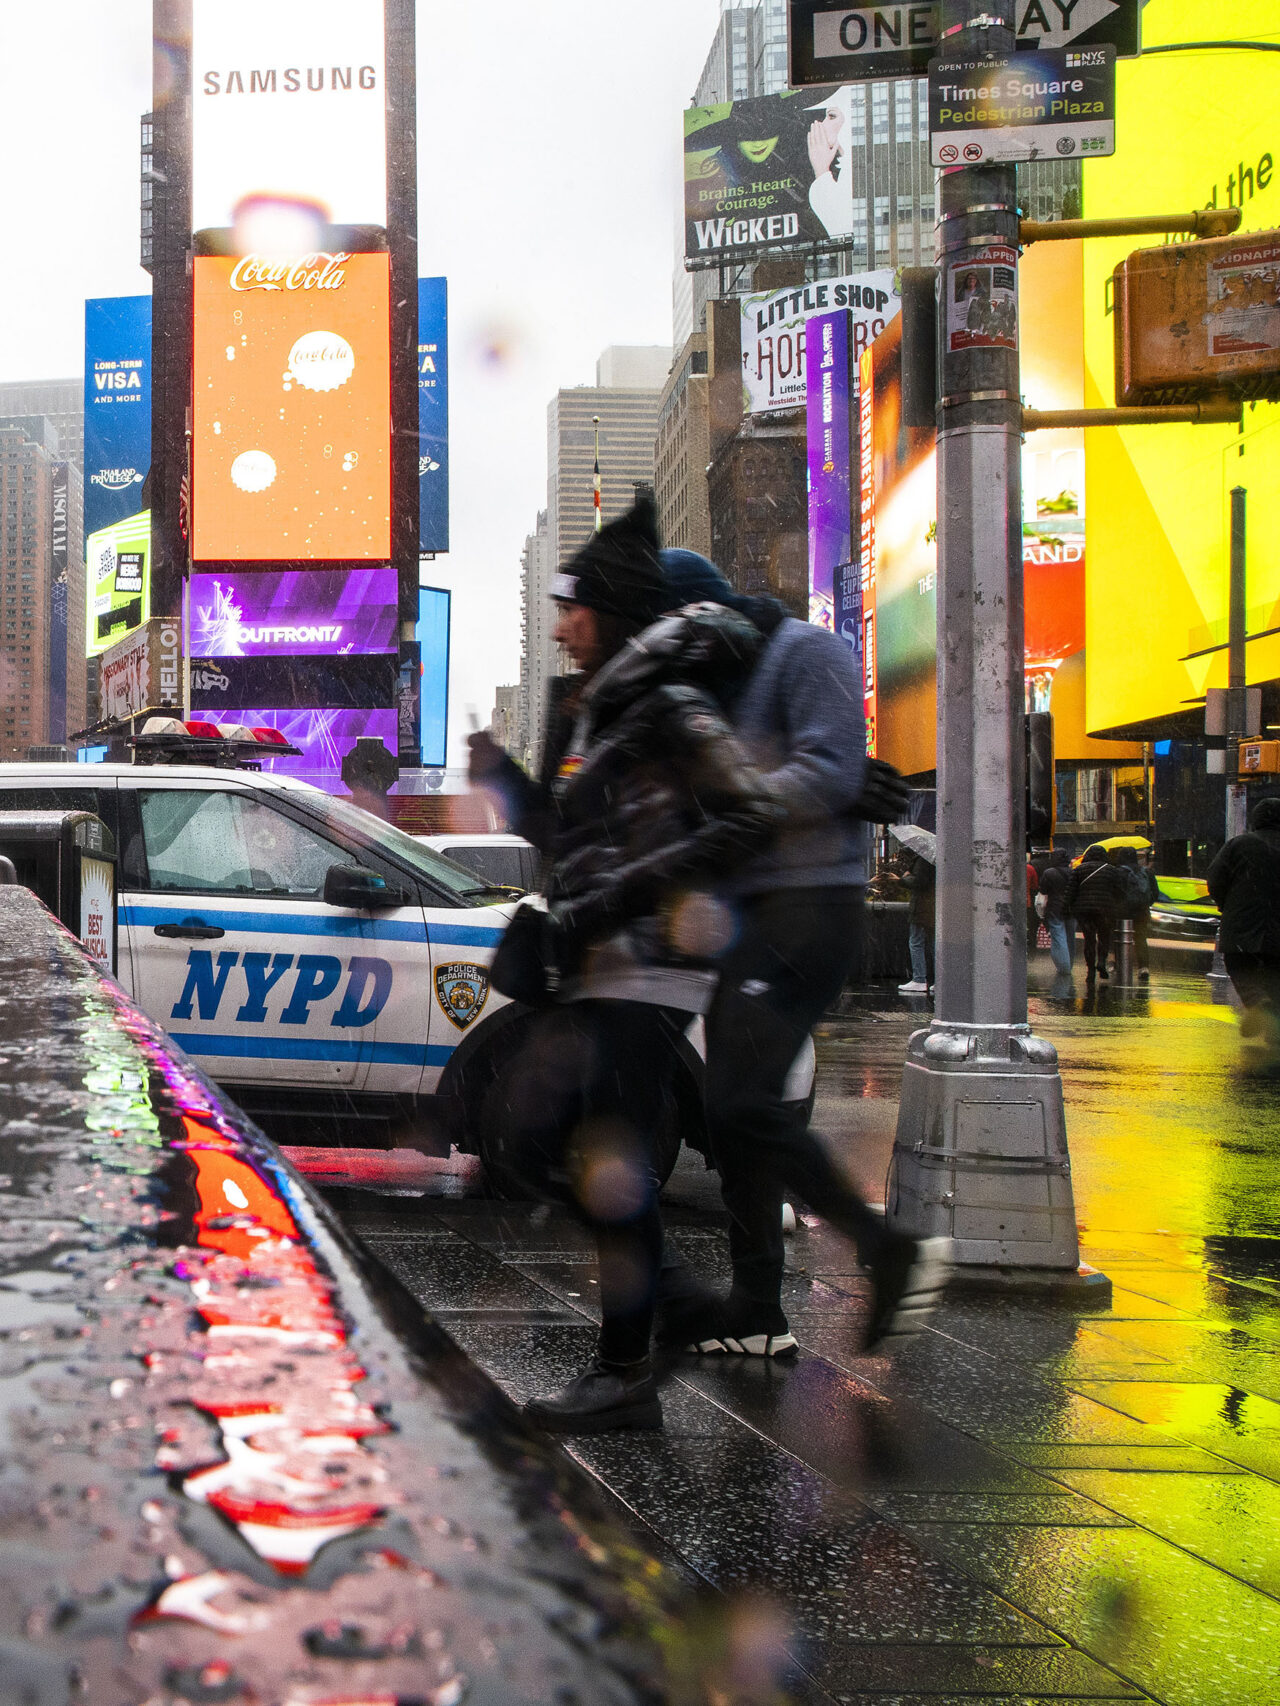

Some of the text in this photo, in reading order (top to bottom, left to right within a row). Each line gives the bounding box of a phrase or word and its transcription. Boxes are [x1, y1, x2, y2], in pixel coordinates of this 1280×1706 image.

[1019, 0, 1079, 35] AY
[839, 8, 933, 50] ONE
[938, 59, 1009, 72] OPEN TO PUBLIC
[1081, 51, 1106, 61] NYC
[203, 65, 377, 96] SAMSUNG
[938, 79, 1084, 102] Times Square
[939, 99, 1105, 124] Pedestrian Plaza
[698, 177, 797, 202] Brains. Heart.
[1227, 153, 1273, 209] the
[715, 195, 779, 212] Courage.
[1220, 248, 1280, 264] KIDNAPP
[757, 284, 889, 334] LITTLE SHOP
[418, 344, 437, 353] ERM
[757, 318, 886, 394] HORRS
[94, 360, 143, 370] LONG-TERM
[94, 371, 141, 390] VISA
[780, 382, 807, 394] LittleS
[116, 394, 141, 403] MORE
[768, 396, 796, 406] Westside
[90, 474, 132, 484] PRIVILEGE
[100, 468, 136, 478] THAILAND
[861, 387, 872, 592] HERSHEY'S STORE
[1022, 543, 1082, 566] AND
[842, 563, 862, 580] BROAD
[918, 573, 934, 595] THE
[842, 592, 862, 610] CELEB
[161, 623, 178, 704] HELLO!
[88, 914, 103, 935] BEST
[437, 973, 487, 984] DEPARTMENT
[448, 965, 478, 974] POLICE
[171, 950, 393, 1028] NYPD
[438, 987, 488, 1022] CITY OF NEW YORK
